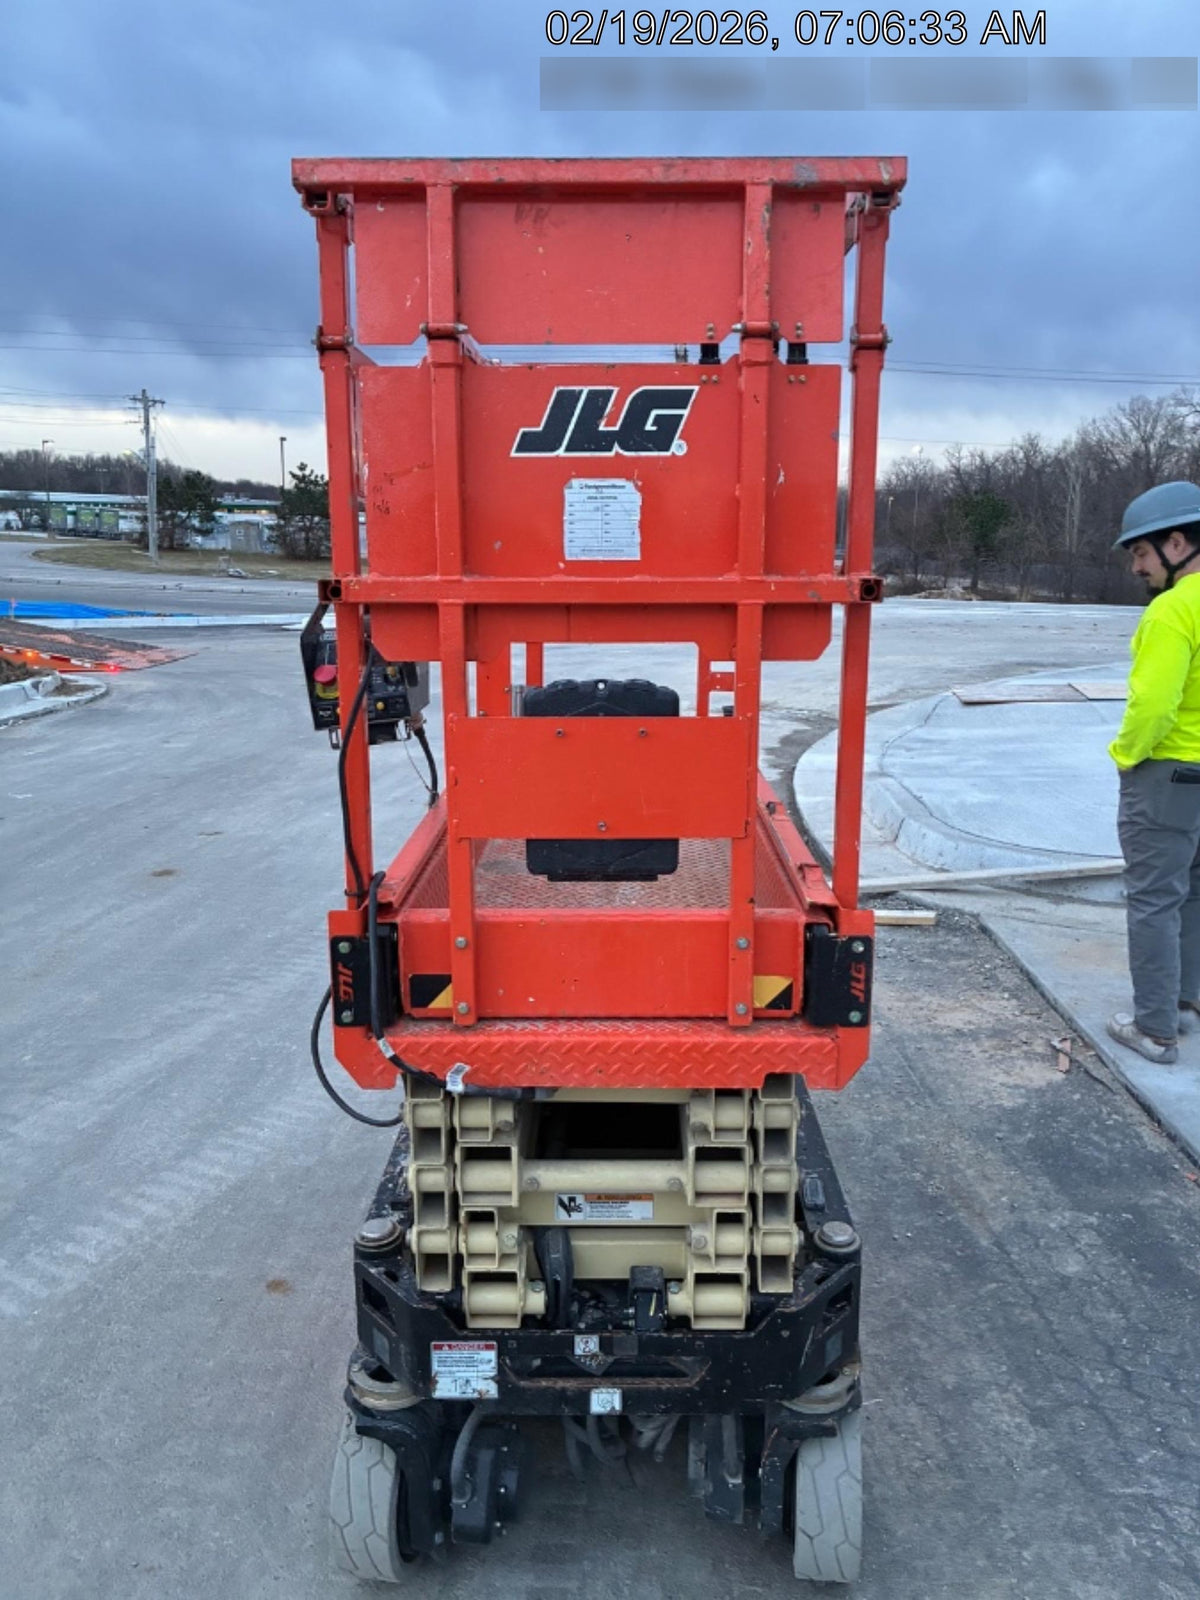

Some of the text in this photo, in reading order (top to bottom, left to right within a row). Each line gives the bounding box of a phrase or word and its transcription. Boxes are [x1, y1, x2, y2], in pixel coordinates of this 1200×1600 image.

[510, 385, 699, 457] JLG
[337, 961, 355, 1003] JLG
[849, 961, 866, 1004] JLG
